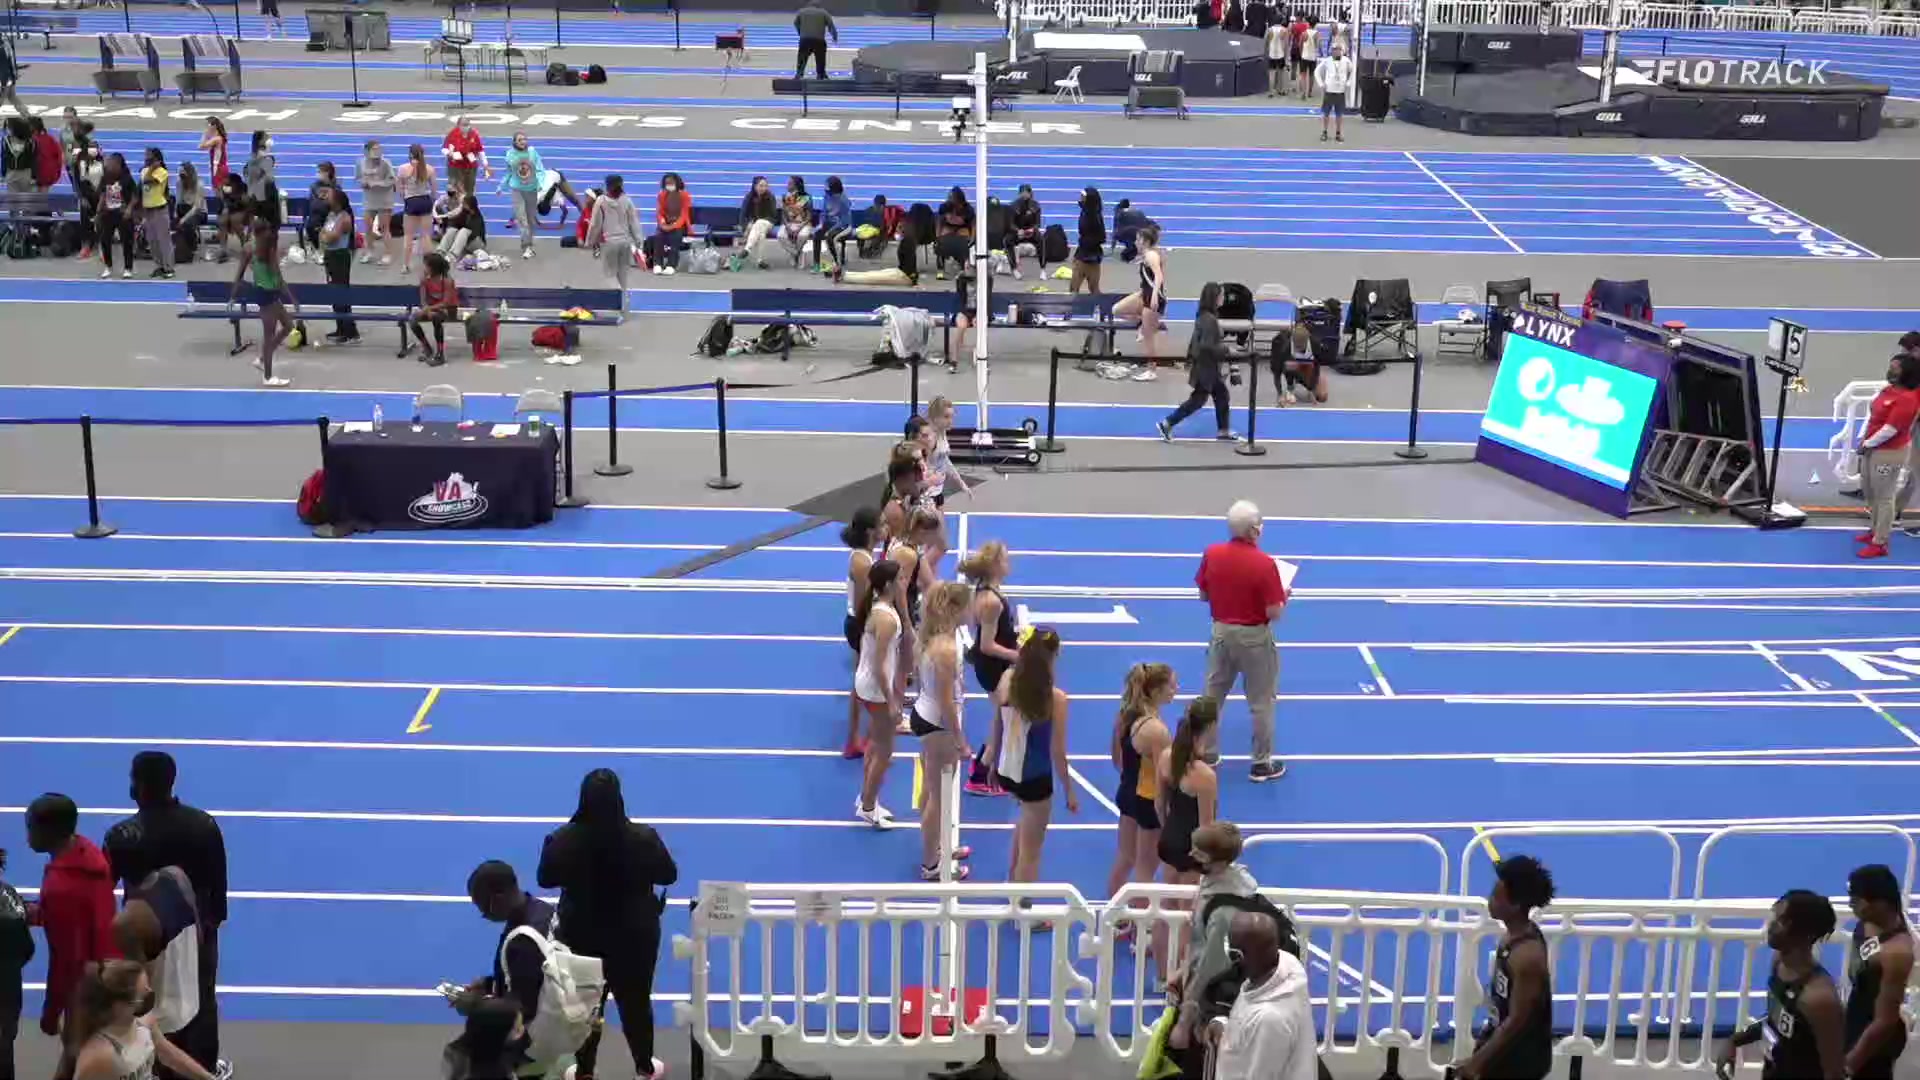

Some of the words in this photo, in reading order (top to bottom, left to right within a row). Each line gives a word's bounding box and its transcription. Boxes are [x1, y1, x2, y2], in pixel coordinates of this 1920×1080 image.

[332, 111, 687, 127] SPORTS
[730, 117, 1085, 135] CENTER
[1524, 316, 1576, 347] LYNX
[1790, 326, 1801, 355] 5
[434, 480, 462, 501] VA
